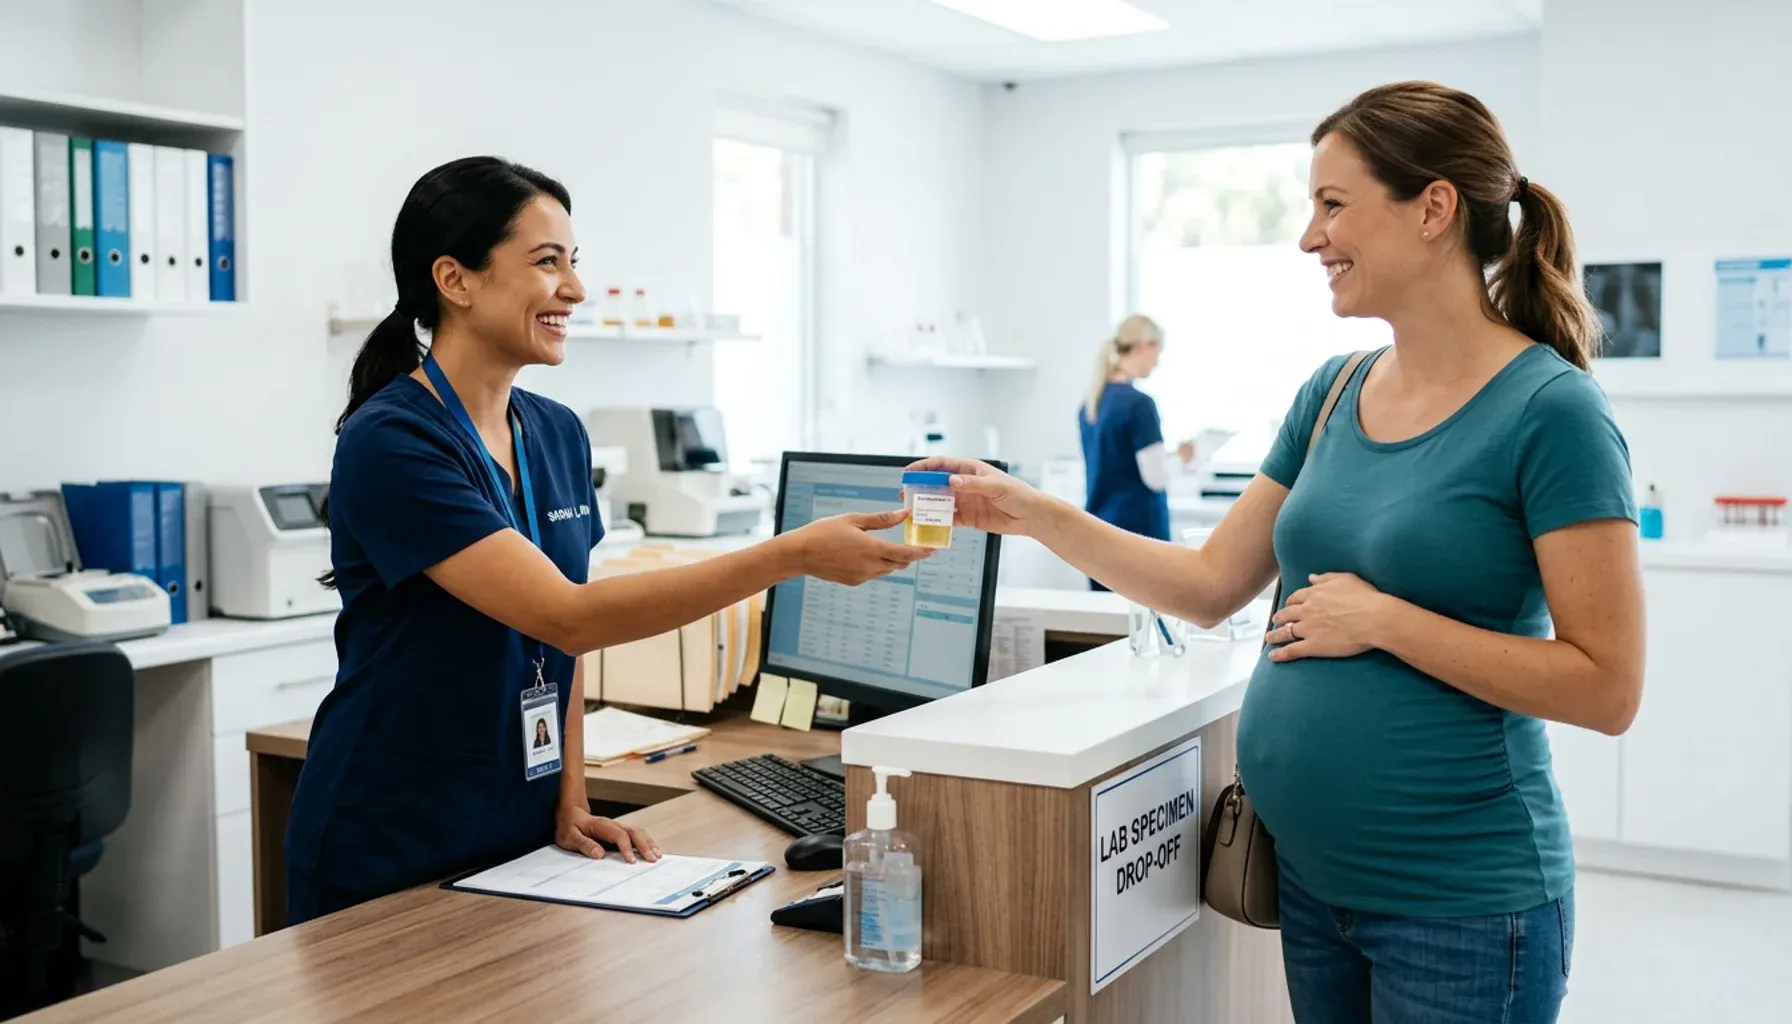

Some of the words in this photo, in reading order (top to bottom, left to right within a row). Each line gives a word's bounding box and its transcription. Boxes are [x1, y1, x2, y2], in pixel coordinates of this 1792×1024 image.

[1100, 825, 1128, 862] LAB
[1131, 788, 1194, 845] SPECIMEN
[1116, 834, 1181, 894] DROP-OFF
